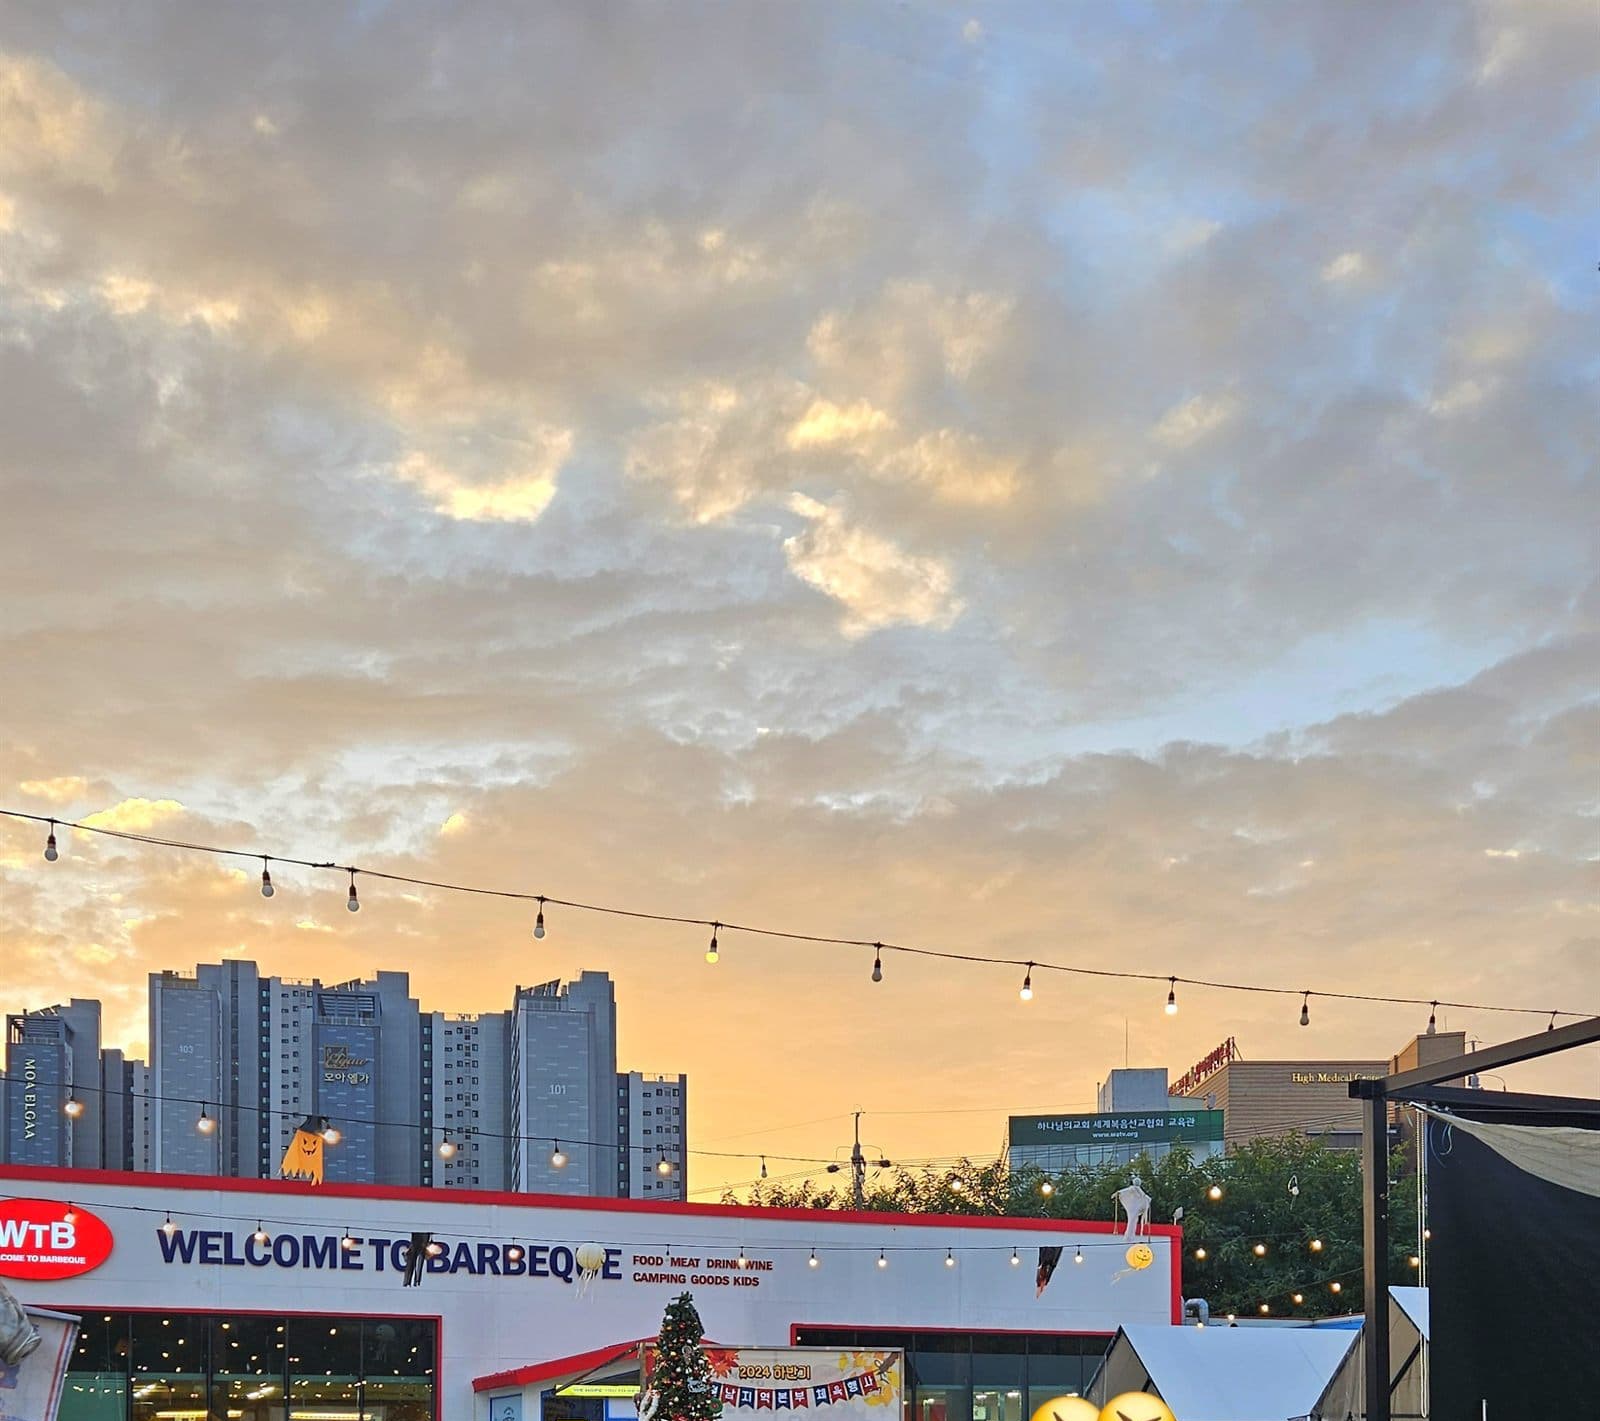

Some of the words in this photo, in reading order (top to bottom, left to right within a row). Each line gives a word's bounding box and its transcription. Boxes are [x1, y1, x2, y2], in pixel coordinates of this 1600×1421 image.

[24, 1058, 36, 1089] MOA
[1292, 1073, 1315, 1084] High
[1318, 1072, 1352, 1082] Medical
[550, 1084, 566, 1095] 101
[1037, 1120, 1090, 1131] 하나님의교회
[1168, 1117, 1195, 1127] 교육관
[40, 1256, 86, 1264] BARBEQUE
[157, 1228, 364, 1270] WELCOME
[426, 1241, 623, 1283] BARBEQE
[633, 1255, 664, 1266] FOOD
[670, 1257, 701, 1268] MEAT
[706, 1259, 740, 1269] DRINK
[745, 1260, 773, 1270] WINE
[633, 1272, 686, 1284] CAMPING
[691, 1275, 730, 1286] GOODS
[733, 1276, 760, 1287] KIDS
[738, 1366, 770, 1379] 2024
[773, 1365, 811, 1380] 하반기
[816, 1375, 875, 1401] 체육행사
